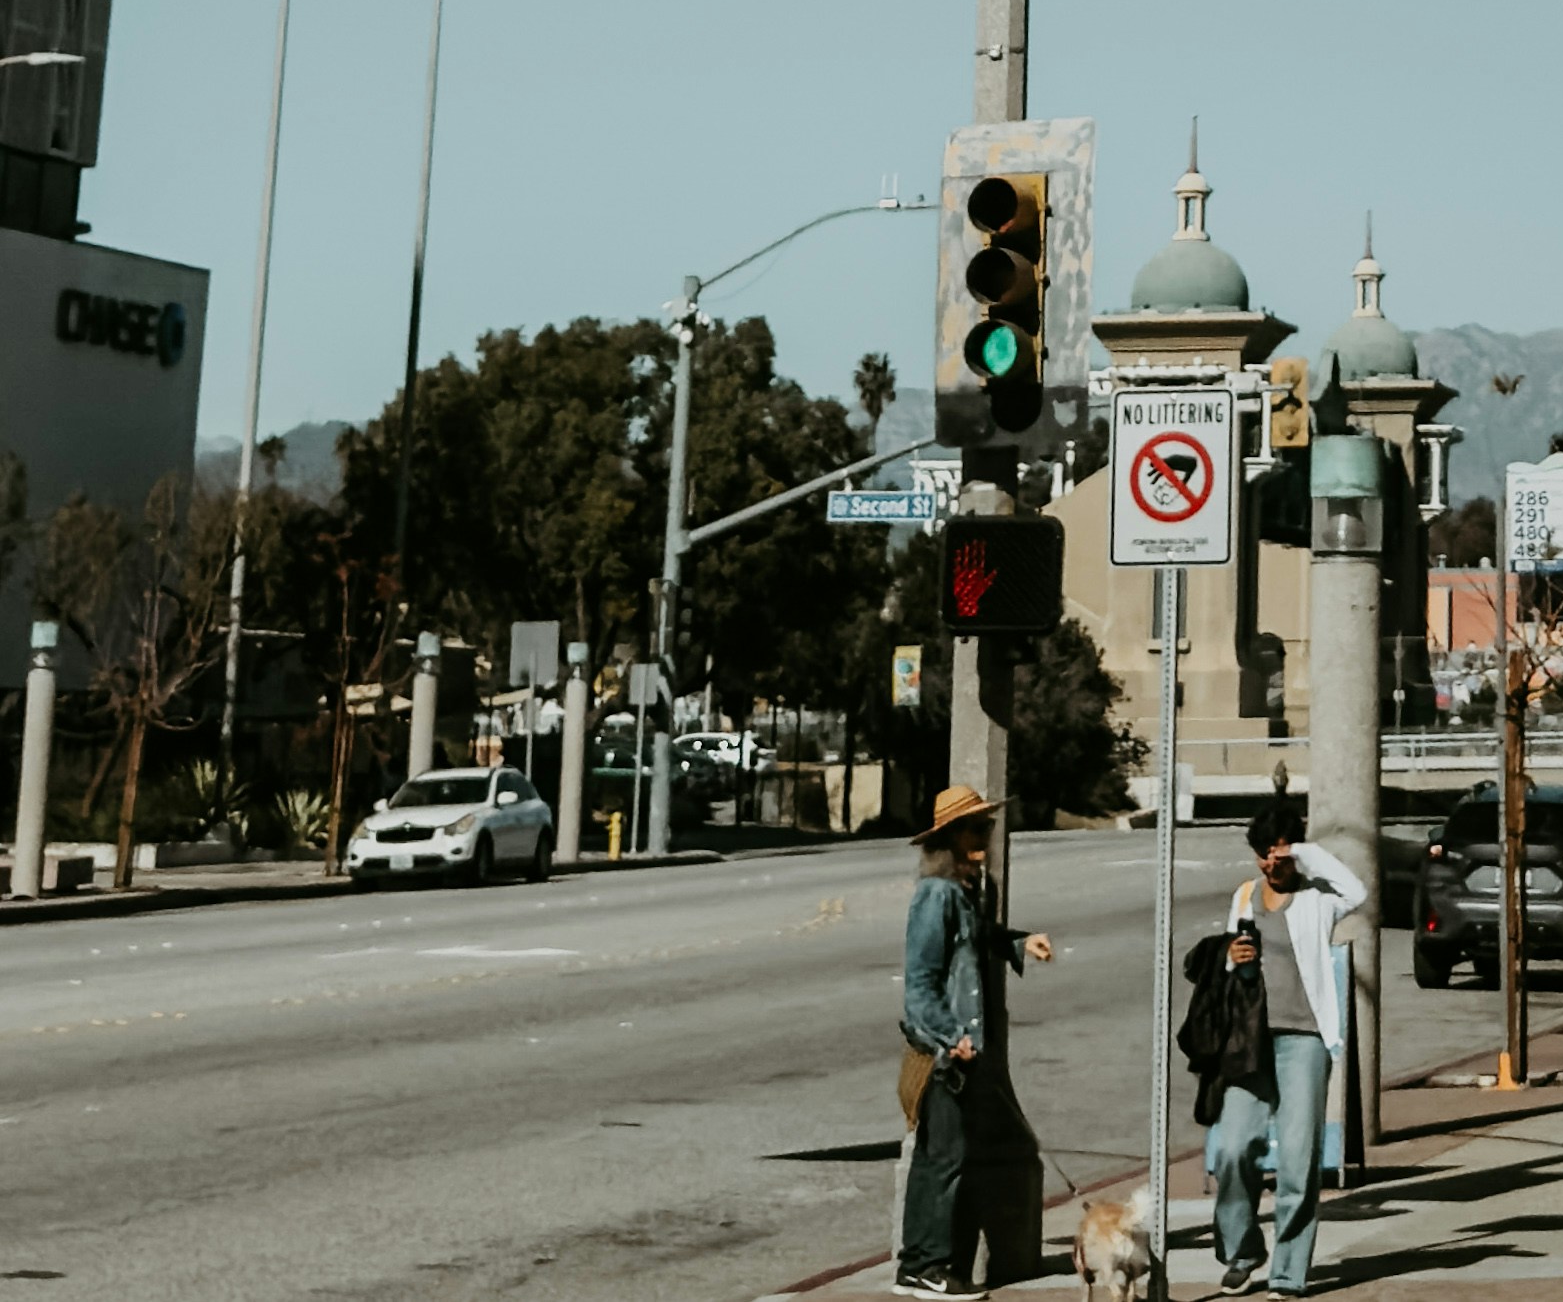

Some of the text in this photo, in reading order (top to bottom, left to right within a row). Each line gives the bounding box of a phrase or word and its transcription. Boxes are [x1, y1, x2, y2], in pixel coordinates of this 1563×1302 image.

[56, 289, 160, 356] CHASE
[1123, 402, 1224, 425] NO LITTERING
[851, 496, 930, 516] Second St
[1514, 490, 1549, 506] 286
[1514, 508, 1545, 523] 291
[1514, 525, 1549, 540] 480
